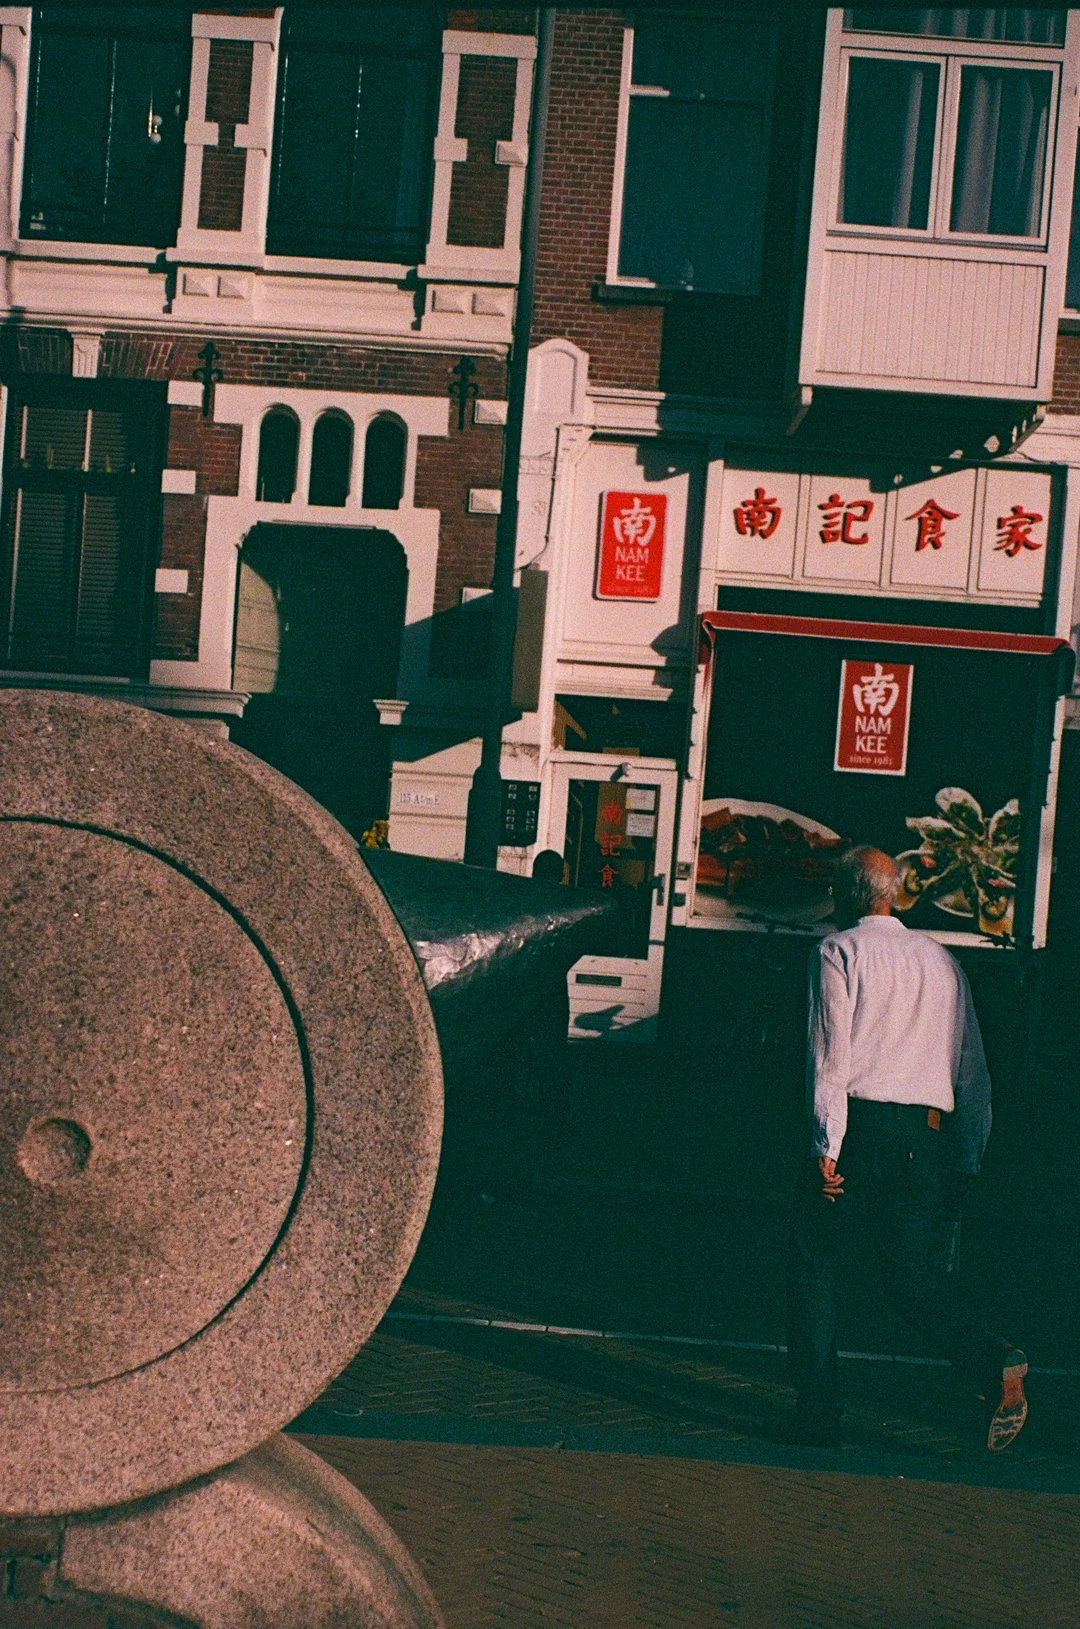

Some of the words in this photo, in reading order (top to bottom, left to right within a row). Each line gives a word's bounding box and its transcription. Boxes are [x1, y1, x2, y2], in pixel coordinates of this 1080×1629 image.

[612, 497, 657, 546] 南
[733, 487, 1044, 557] 南記食家
[615, 546, 650, 564] NAM
[615, 564, 646, 582] KEE
[852, 662, 900, 716] 南
[854, 715, 892, 735] NAM
[855, 735, 888, 754] KEE
